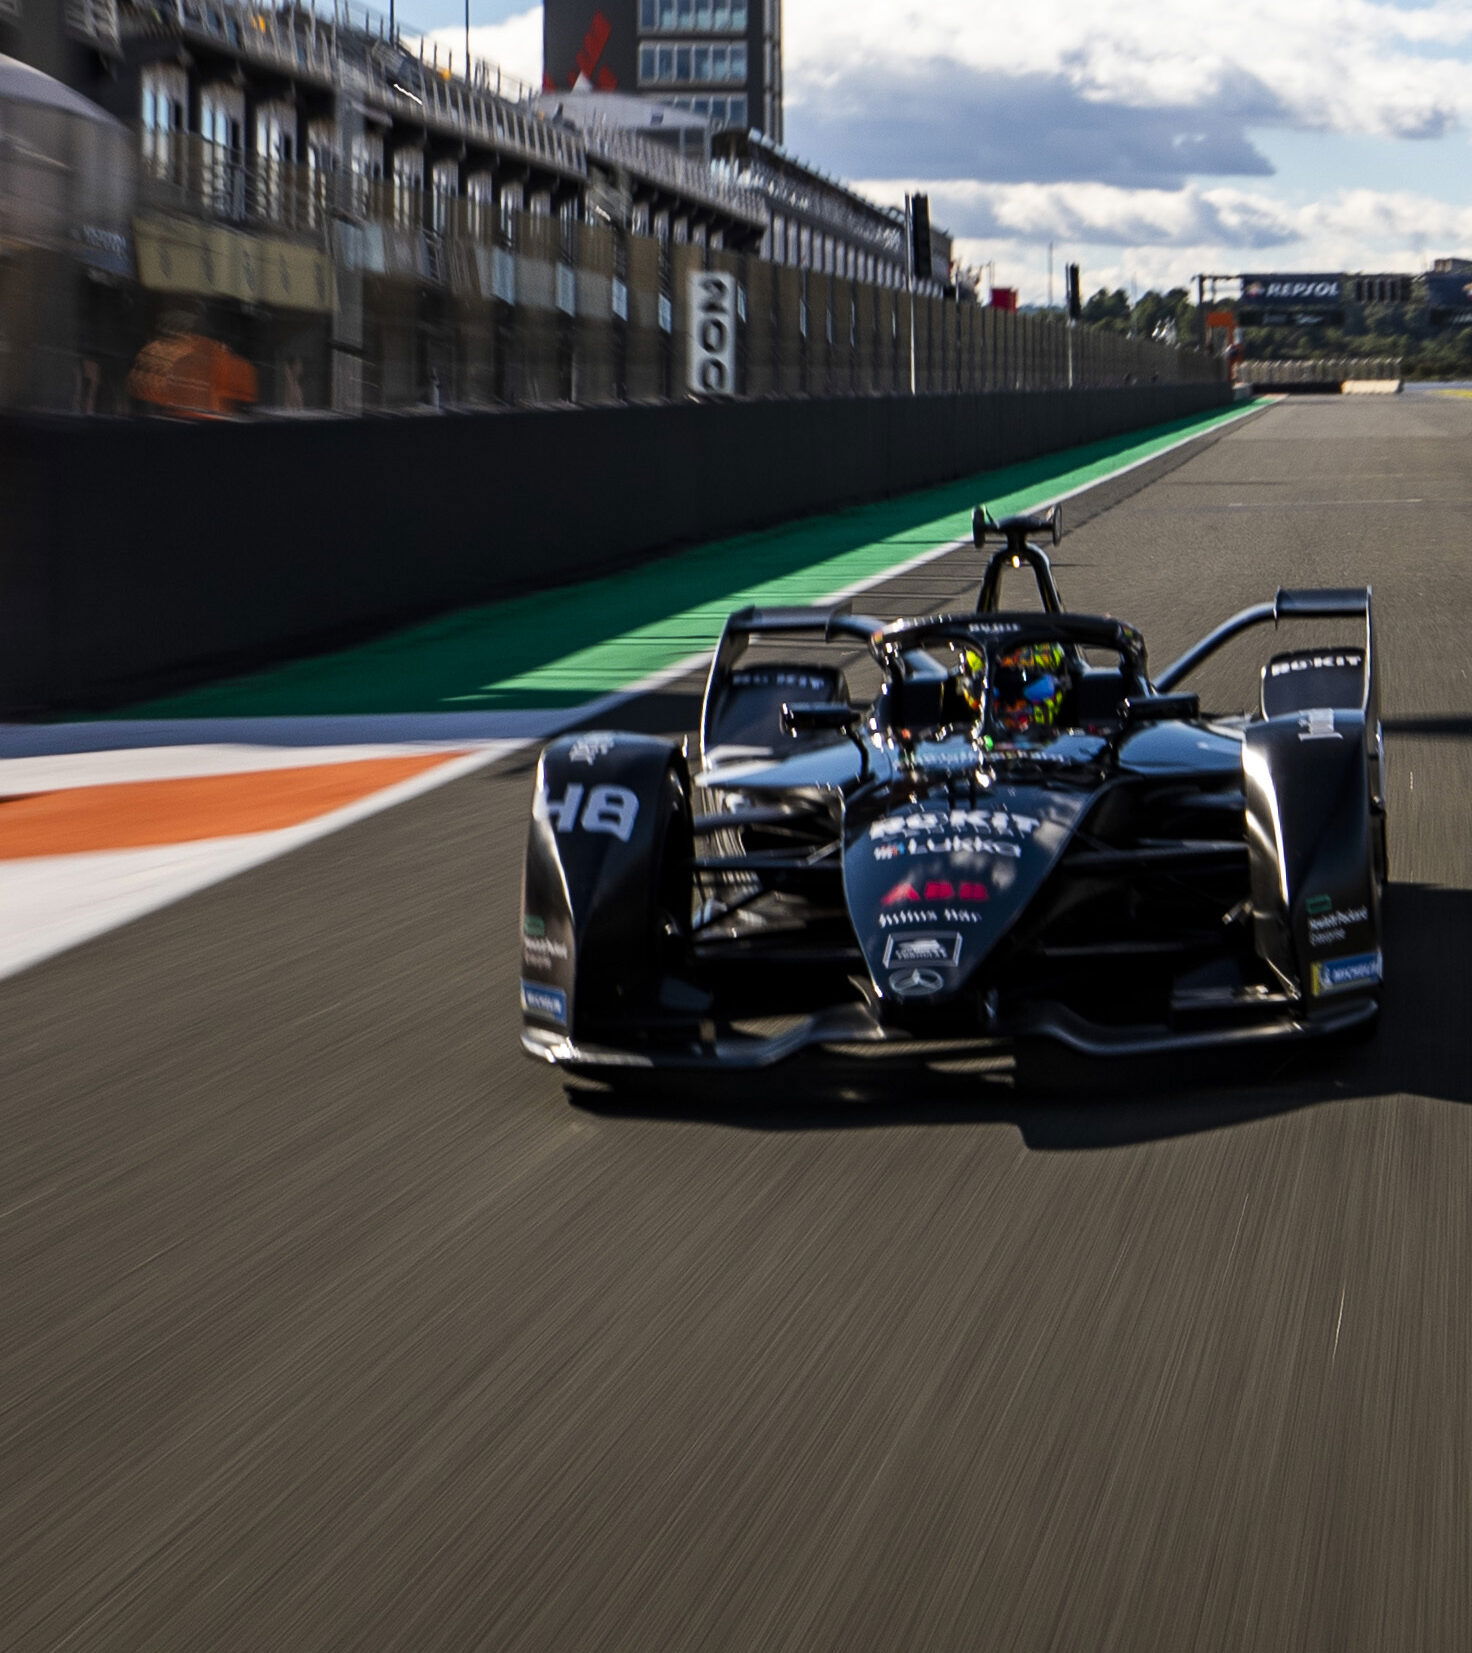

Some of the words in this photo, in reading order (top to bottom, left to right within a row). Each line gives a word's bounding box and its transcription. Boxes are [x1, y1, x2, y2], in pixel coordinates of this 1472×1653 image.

[1266, 282, 1339, 297] REPSOL
[699, 278, 729, 392] 200
[880, 880, 990, 907] ABB
